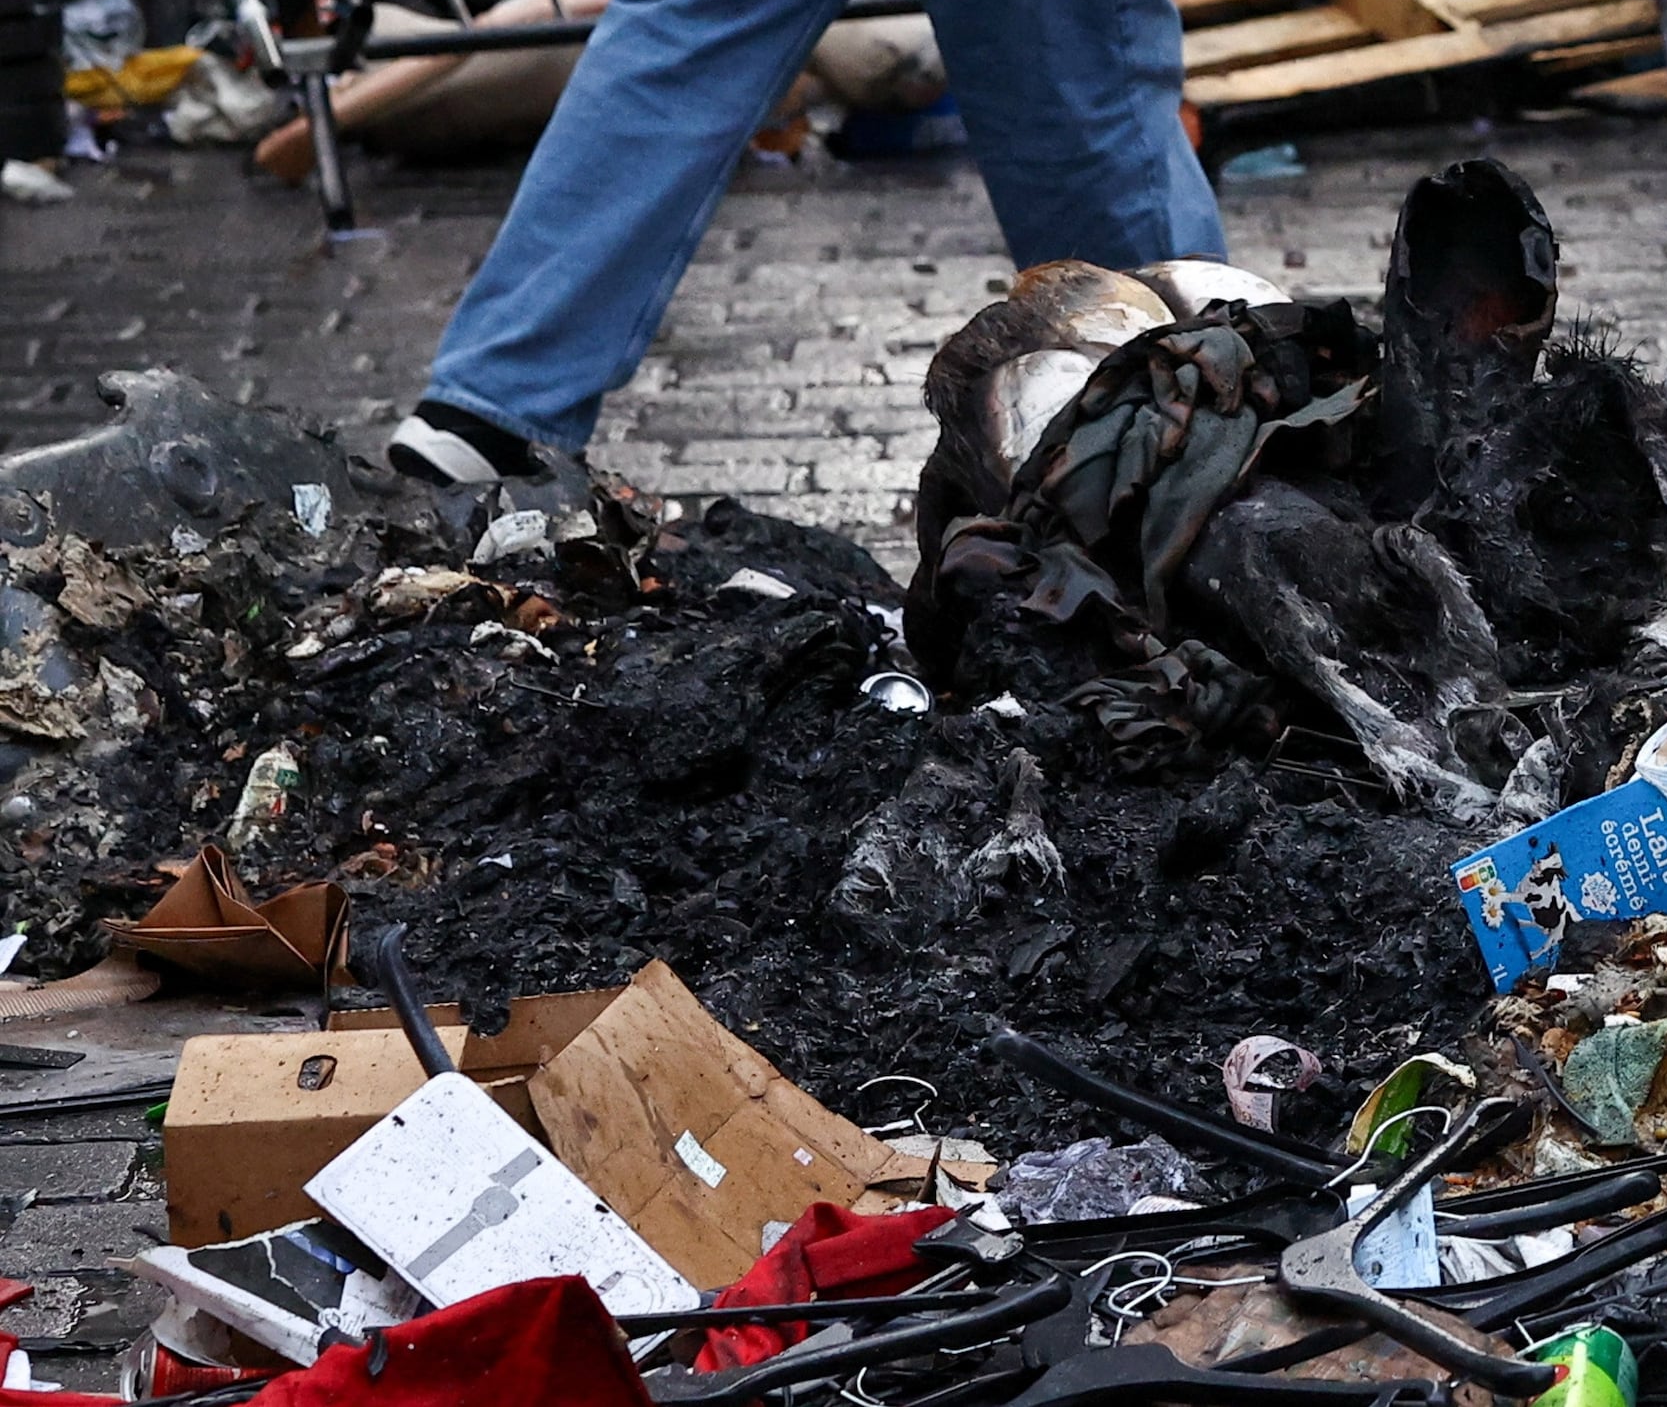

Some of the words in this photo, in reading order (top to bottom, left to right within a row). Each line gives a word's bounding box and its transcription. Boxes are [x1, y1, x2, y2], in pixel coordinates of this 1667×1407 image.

[1600, 819, 1648, 911] écrémé
[1621, 822, 1657, 891] demi-
[1491, 962, 1508, 987] 1L
